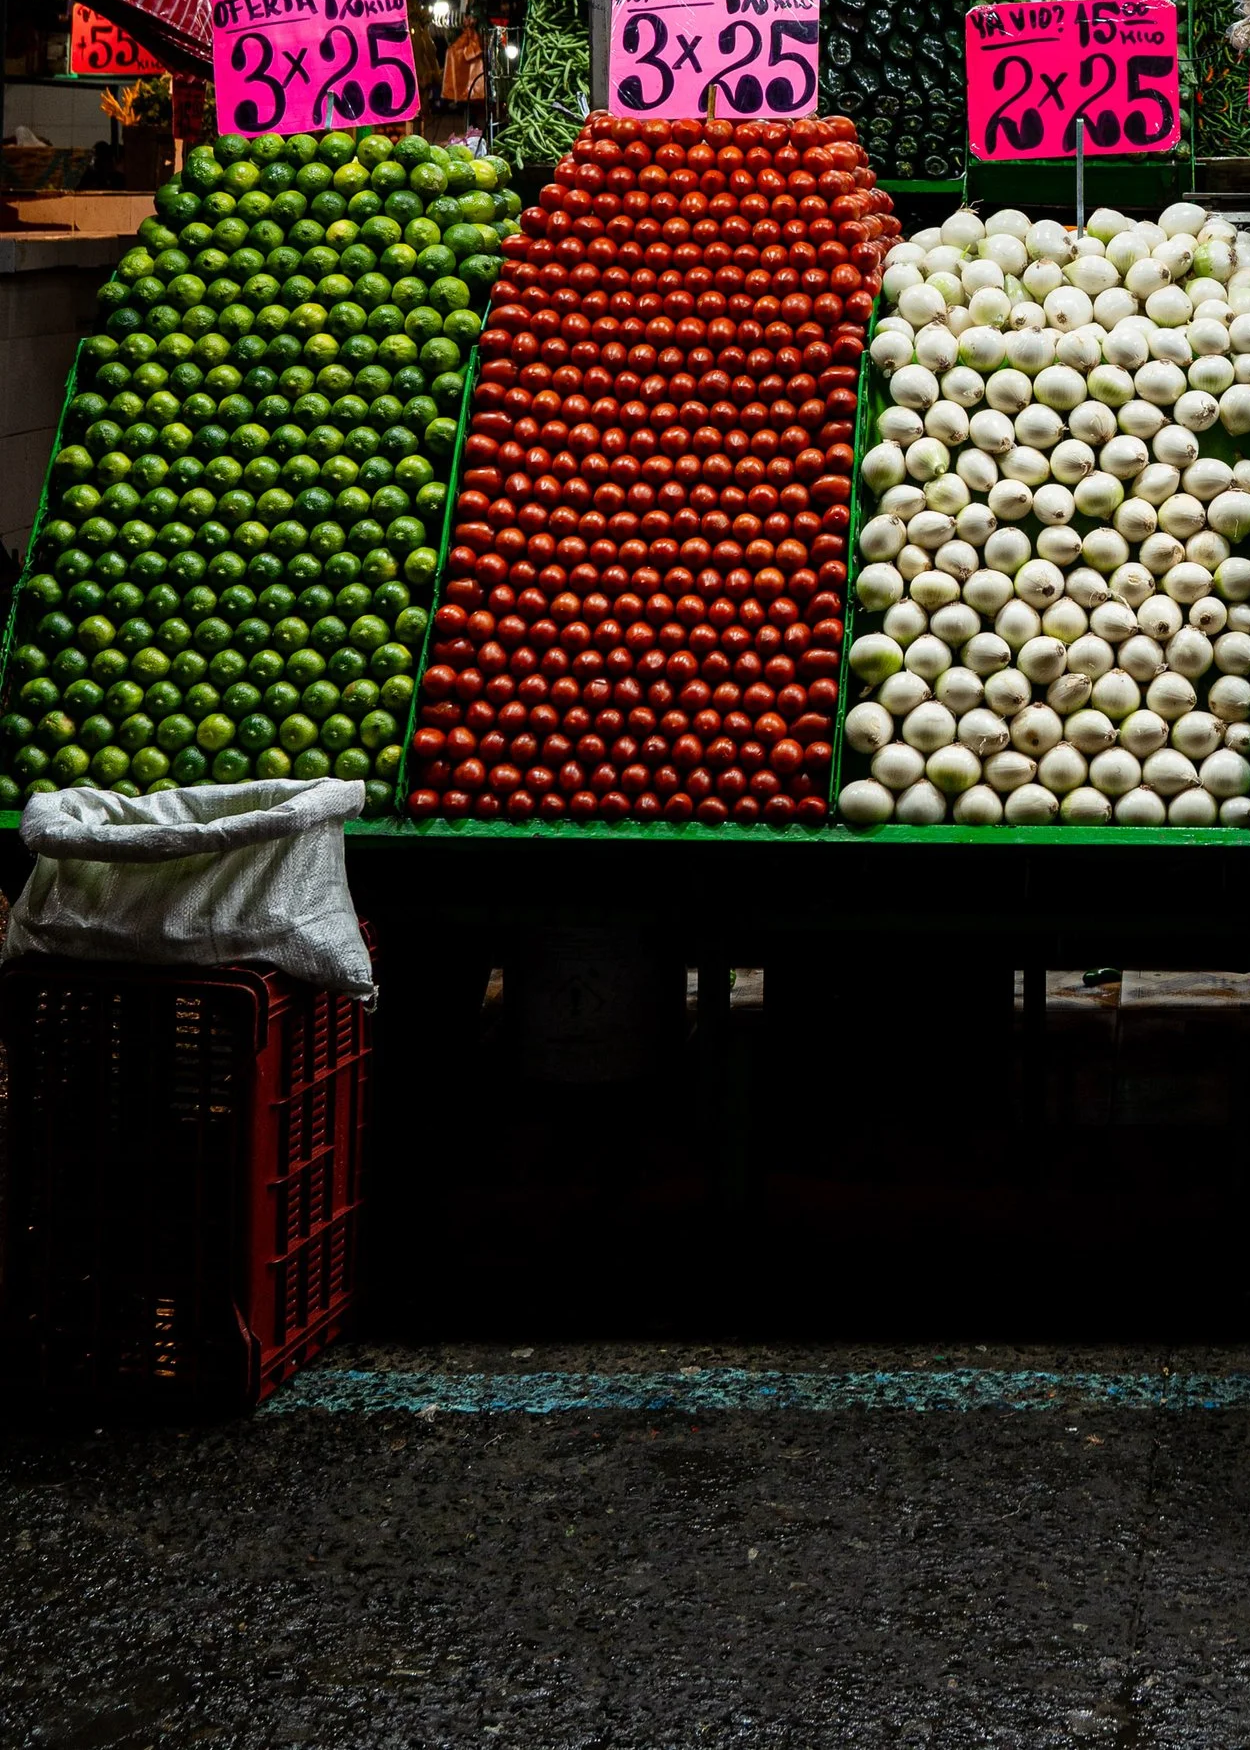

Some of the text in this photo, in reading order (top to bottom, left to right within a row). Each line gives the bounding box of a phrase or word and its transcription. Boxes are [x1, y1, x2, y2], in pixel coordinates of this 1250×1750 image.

[969, 12, 1006, 39] YA
[1074, 2, 1121, 48] 15
[1121, 30, 1165, 45] KILO
